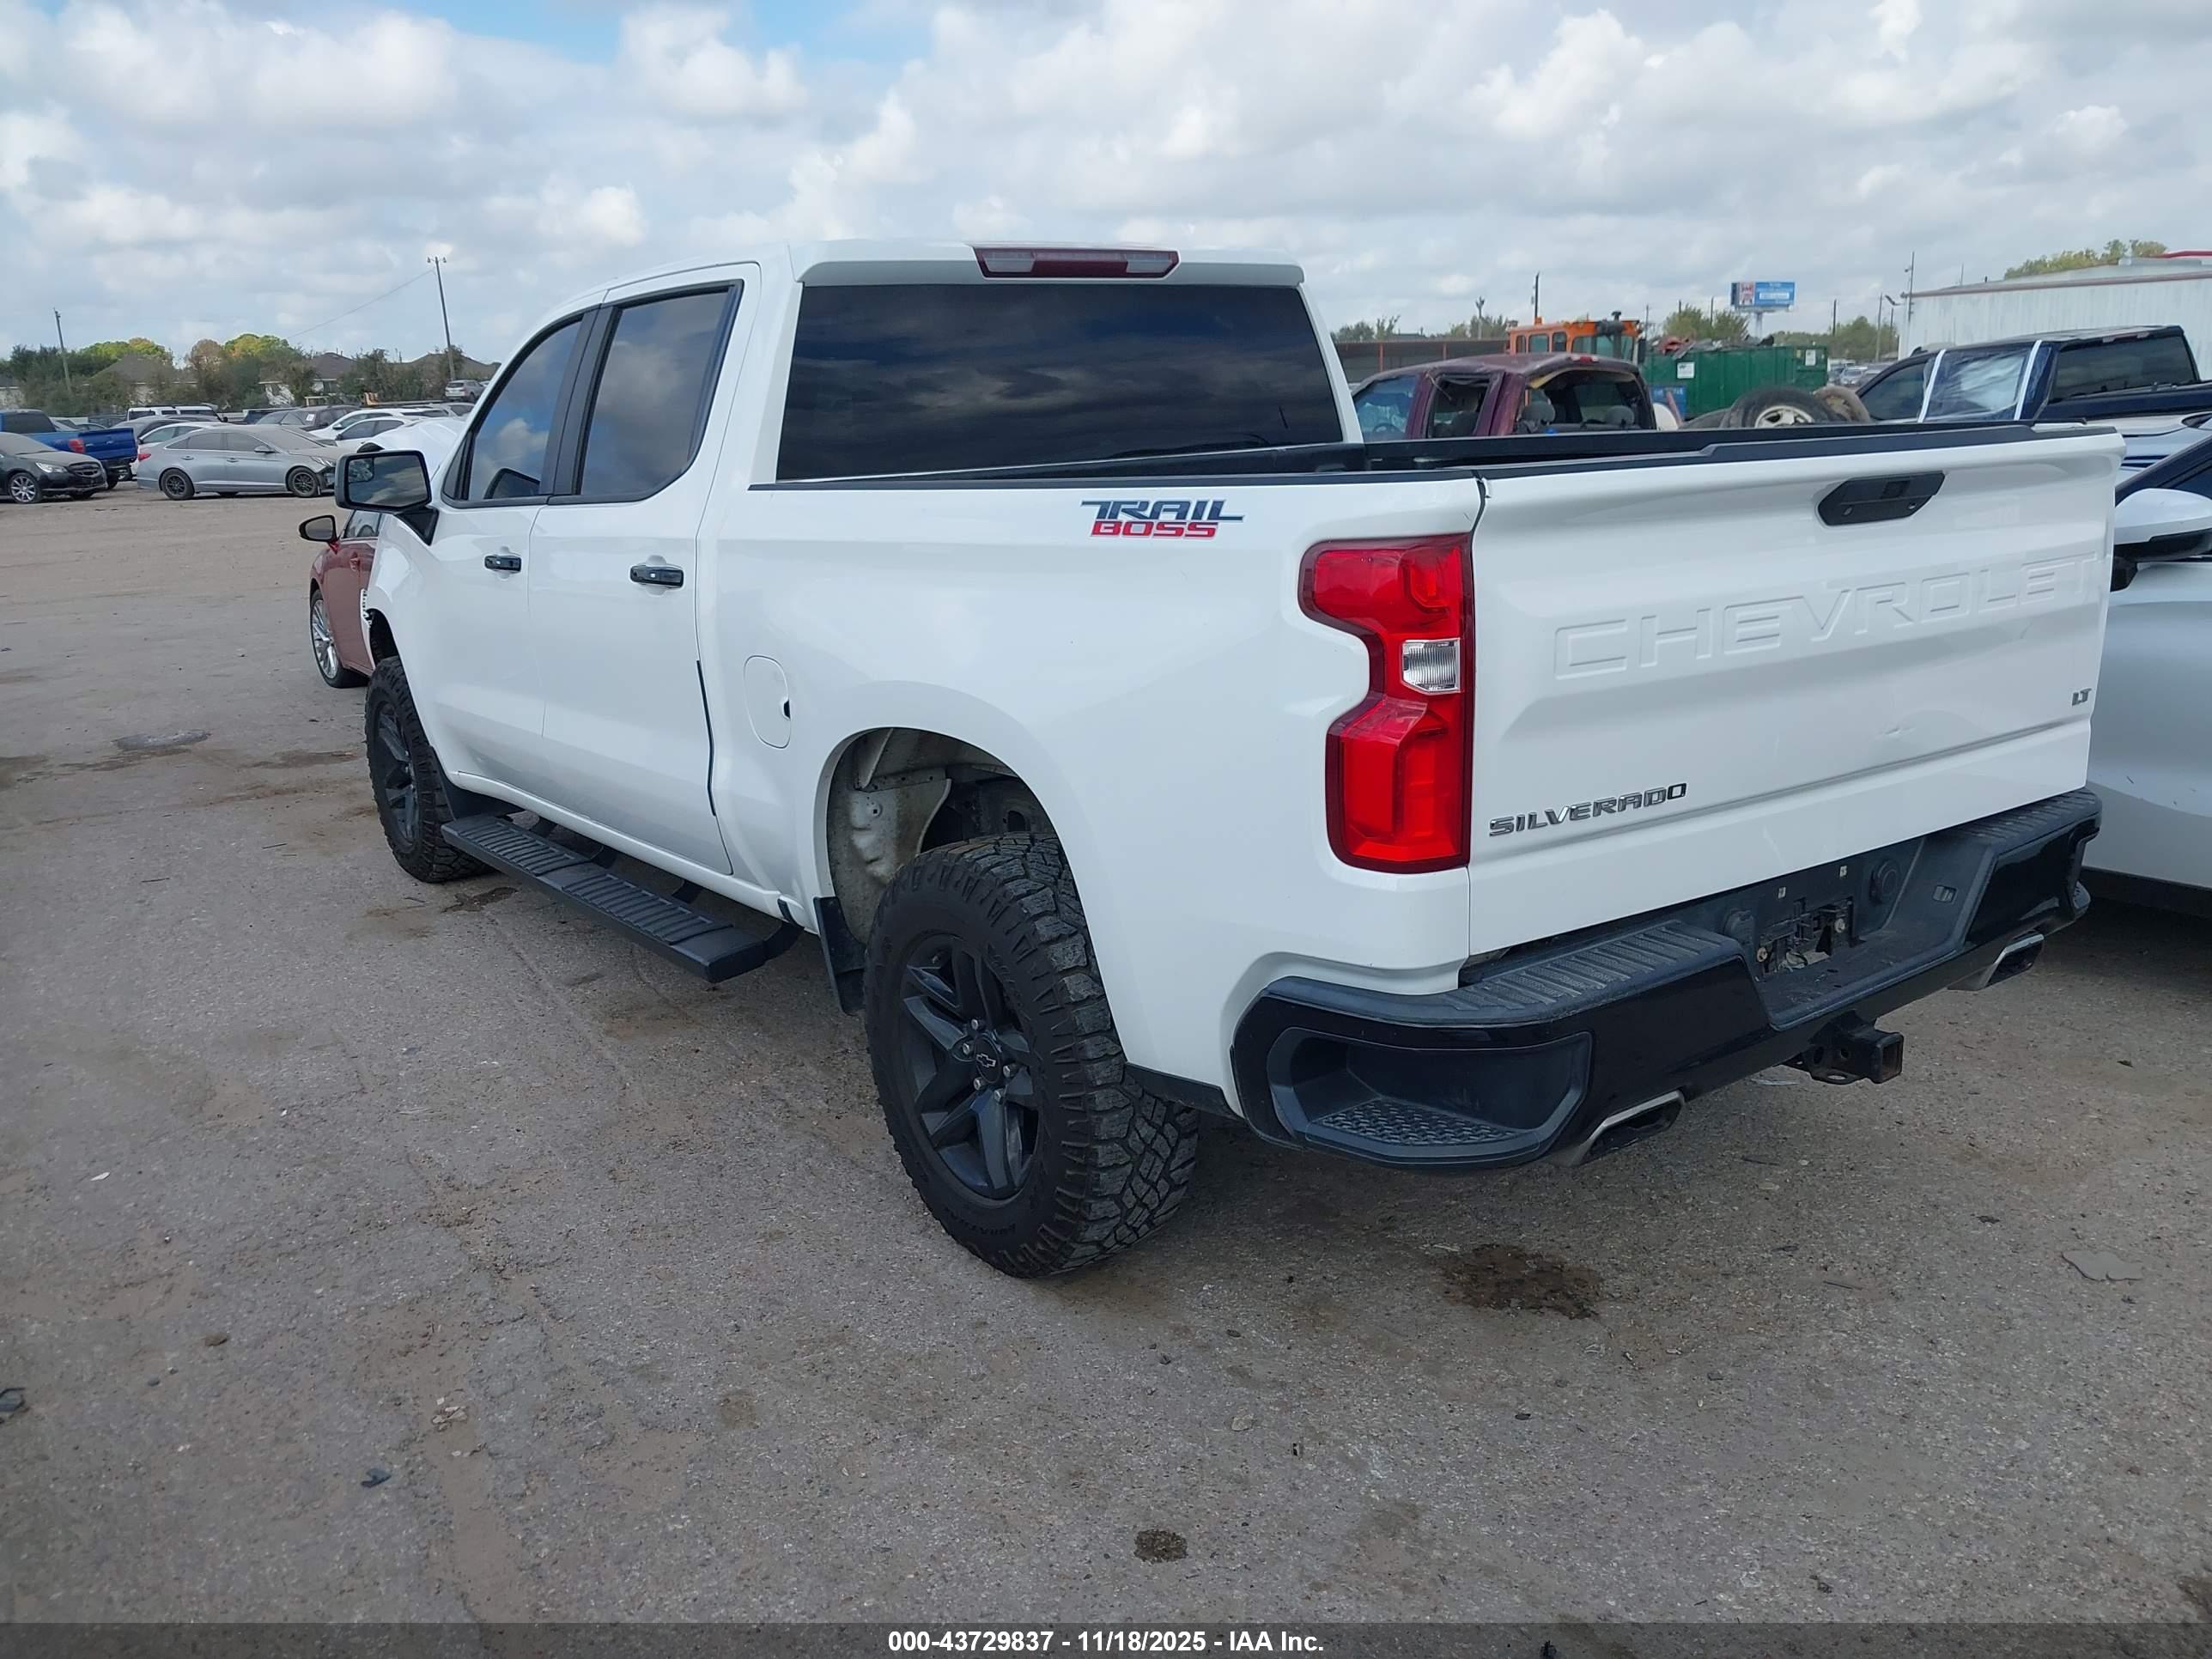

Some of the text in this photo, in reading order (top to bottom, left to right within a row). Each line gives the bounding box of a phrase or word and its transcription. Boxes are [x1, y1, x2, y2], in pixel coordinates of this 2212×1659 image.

[1081, 500, 1244, 520] TRAIL
[1091, 520, 1218, 538] BOSS
[1555, 550, 2098, 680] CHEVROLET
[2071, 688, 2092, 706] LT
[1489, 782, 1686, 836] SILVERADO
